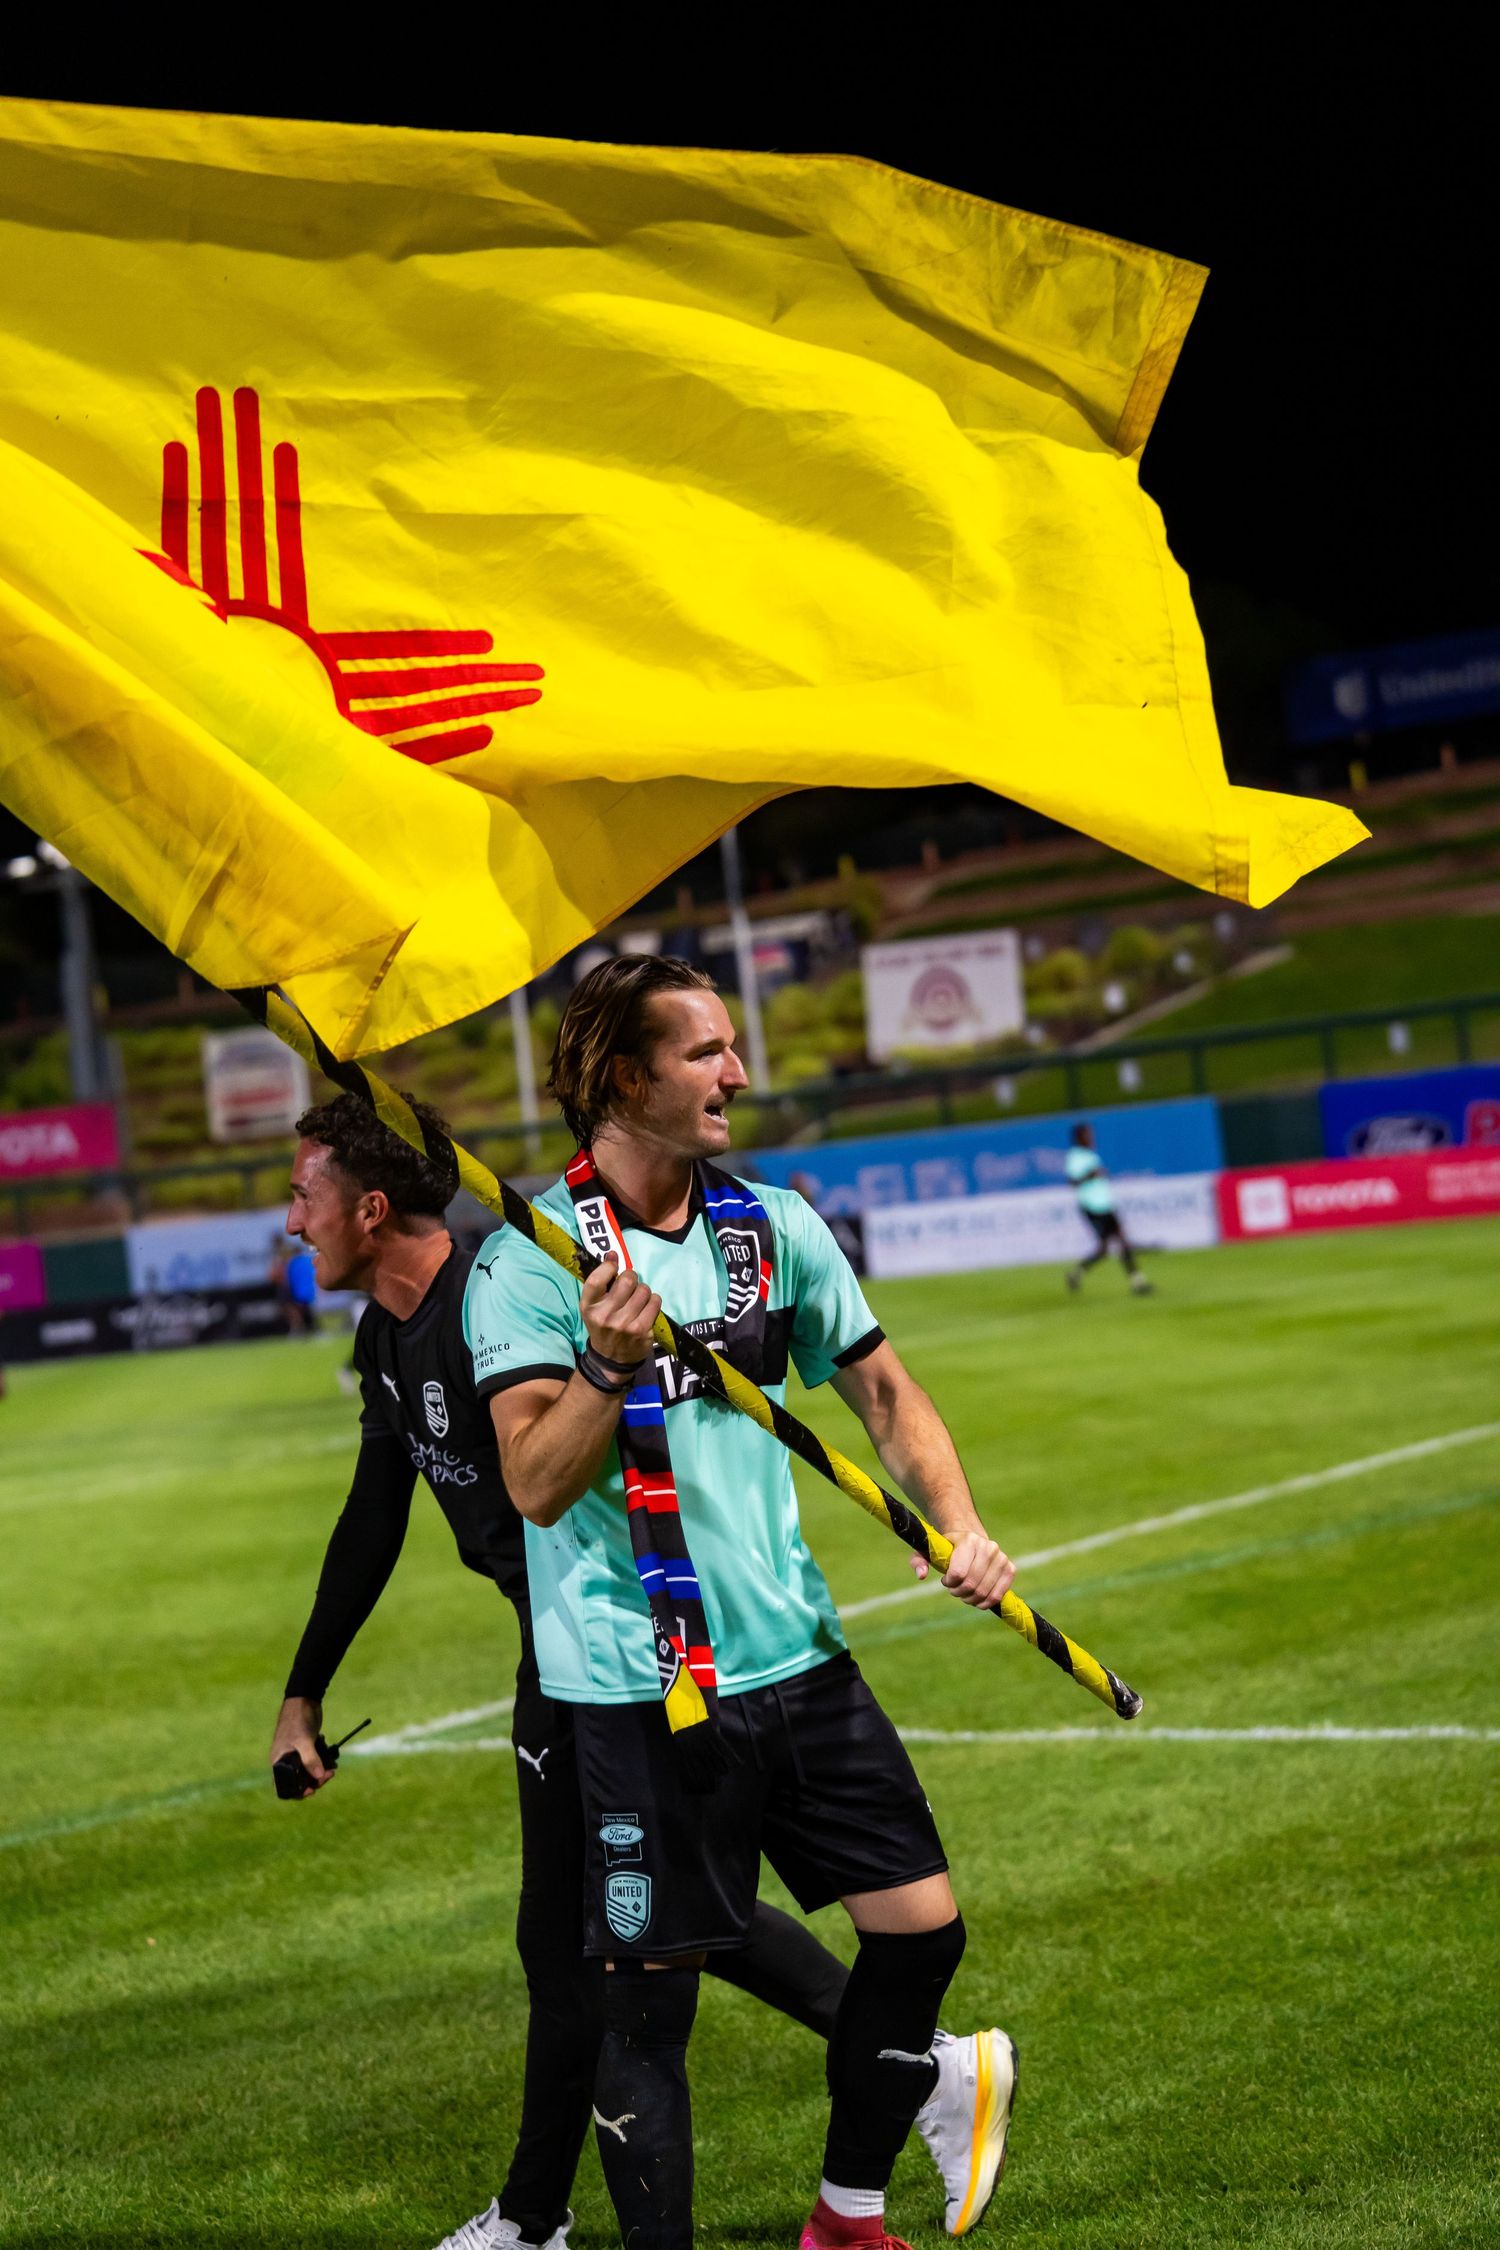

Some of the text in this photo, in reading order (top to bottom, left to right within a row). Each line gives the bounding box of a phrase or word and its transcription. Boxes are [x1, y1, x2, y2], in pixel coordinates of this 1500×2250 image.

[580, 1202, 611, 1262] PEP
[479, 1342, 510, 1359] MEXICO
[477, 1356, 495, 1371] TRUE
[607, 1827, 634, 1841] Ford
[612, 1886, 642, 1898] UNITED
